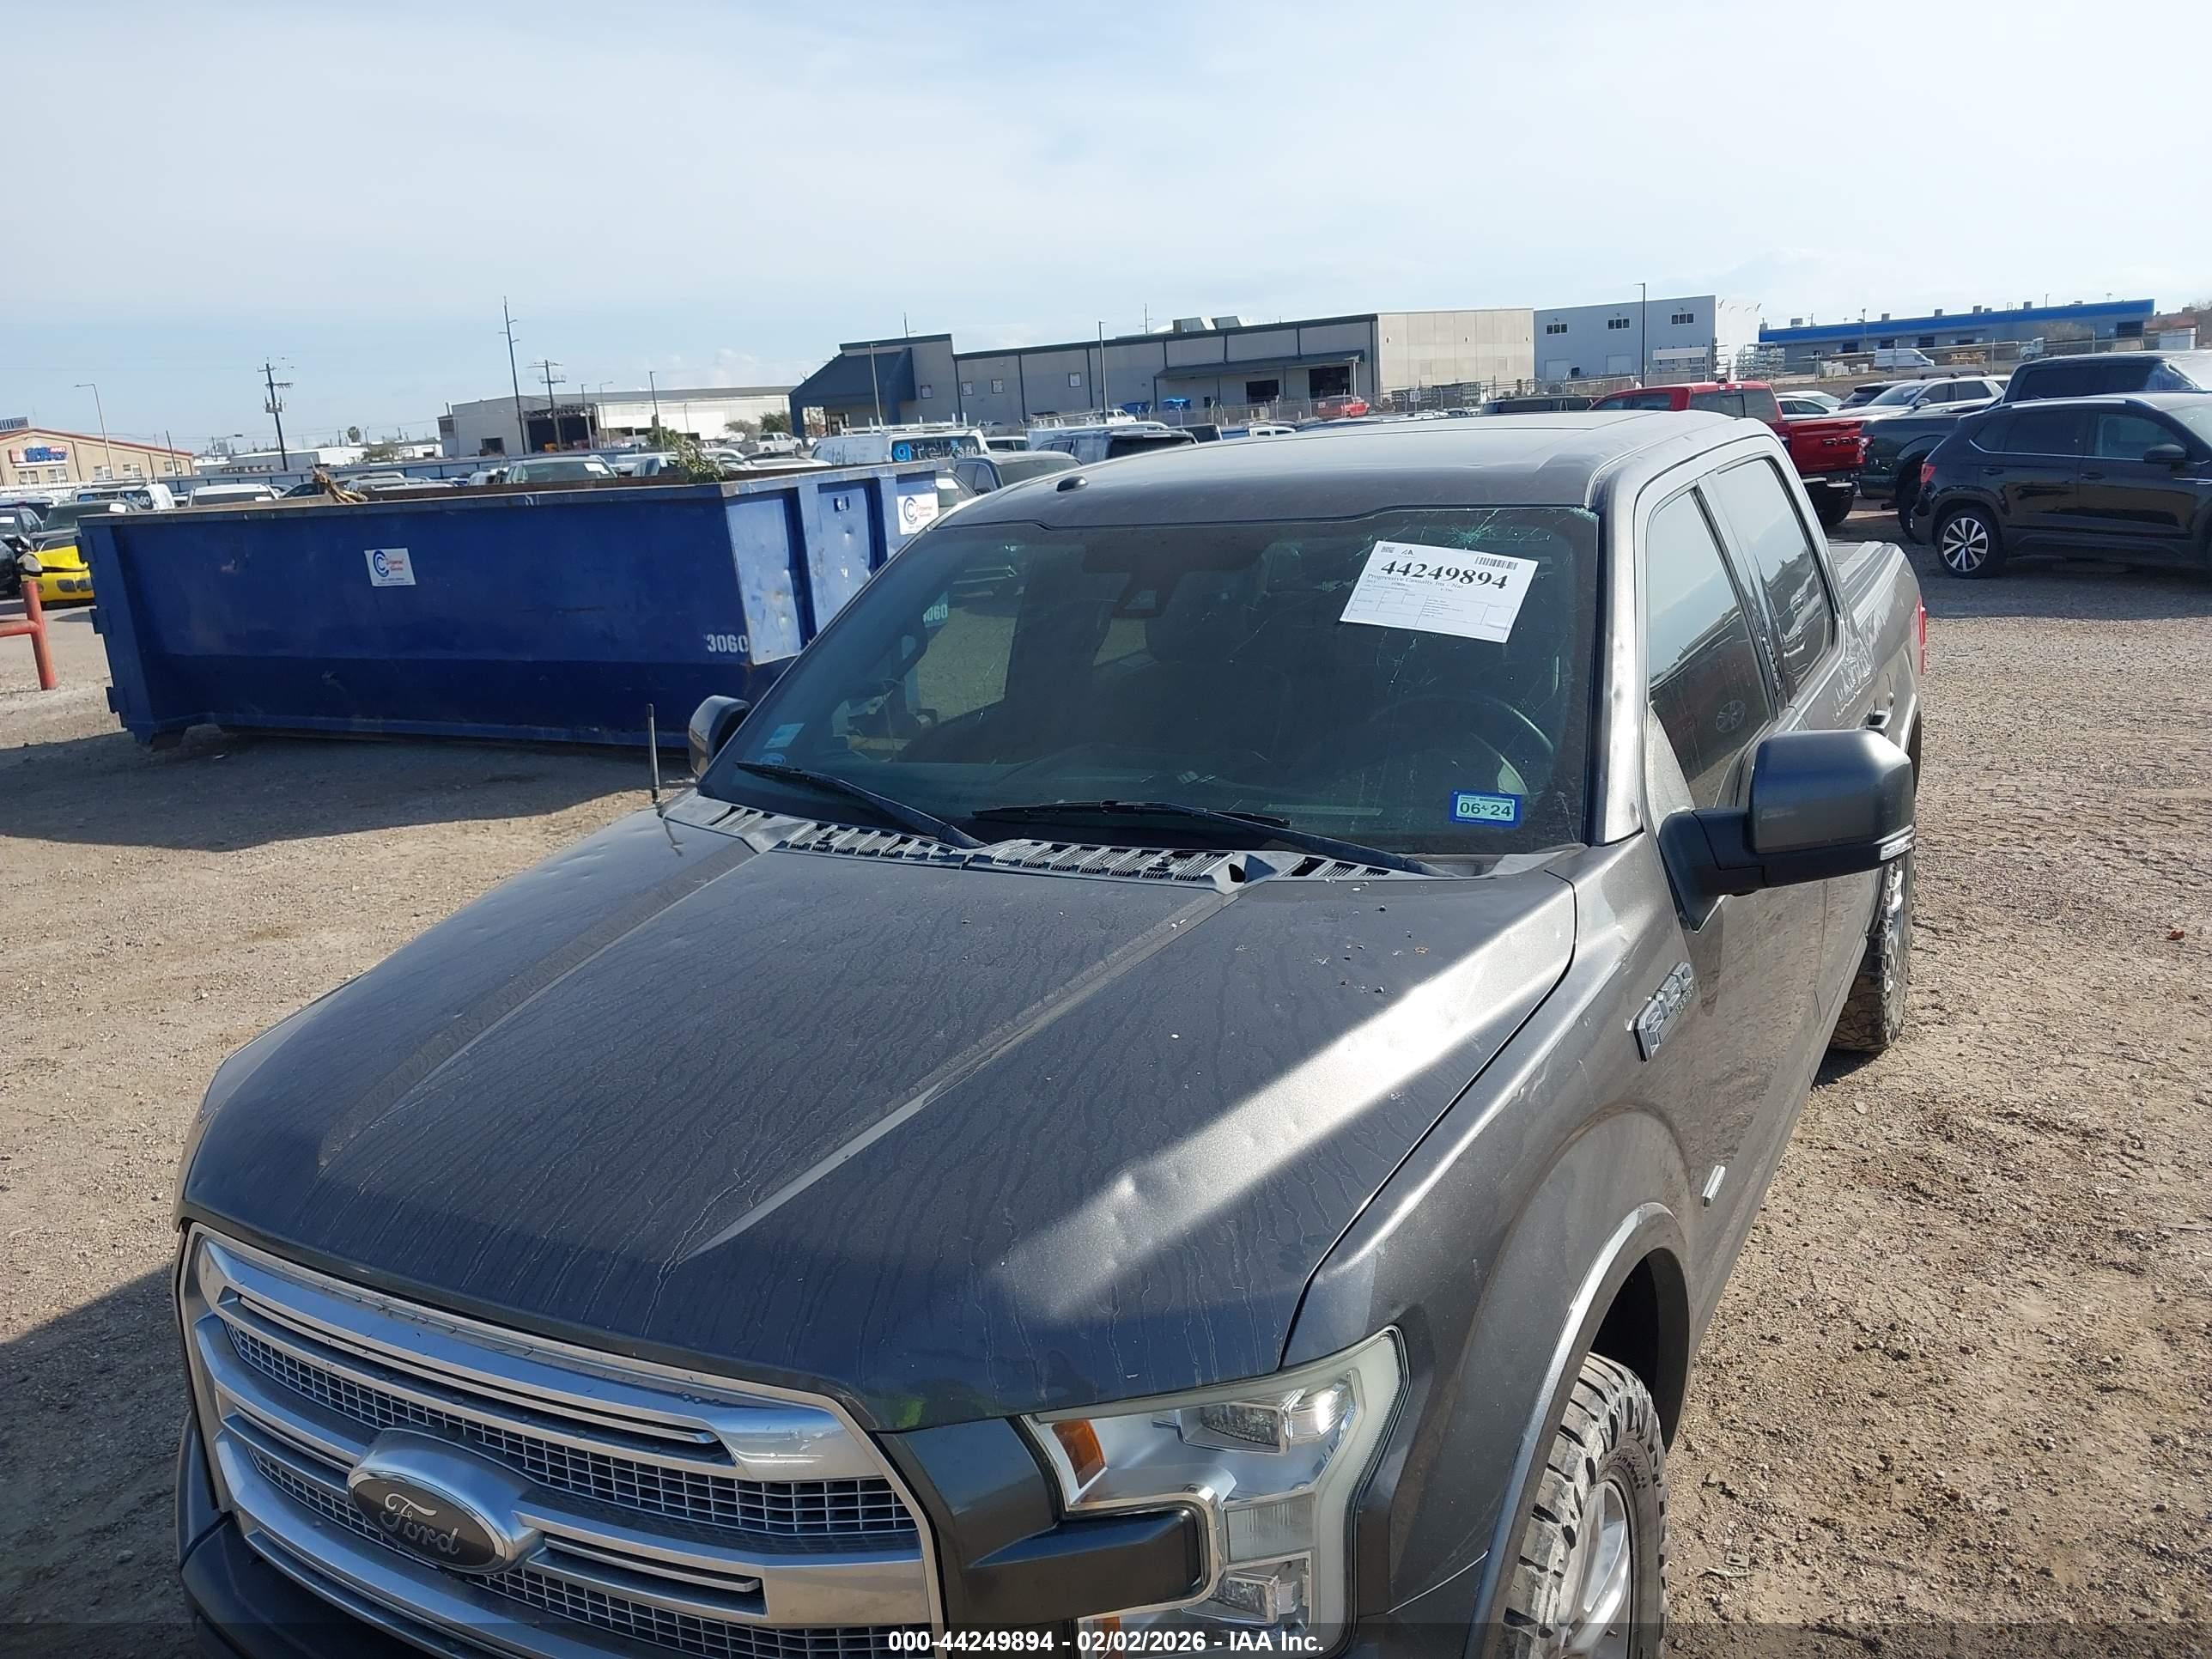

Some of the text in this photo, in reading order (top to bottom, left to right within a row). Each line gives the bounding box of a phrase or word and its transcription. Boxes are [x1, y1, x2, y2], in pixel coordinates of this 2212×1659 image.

[1381, 560, 1509, 589] 44249894
[707, 634, 749, 653] 3060
[1460, 801, 1511, 817] 06 24
[379, 1492, 460, 1556] Ford
